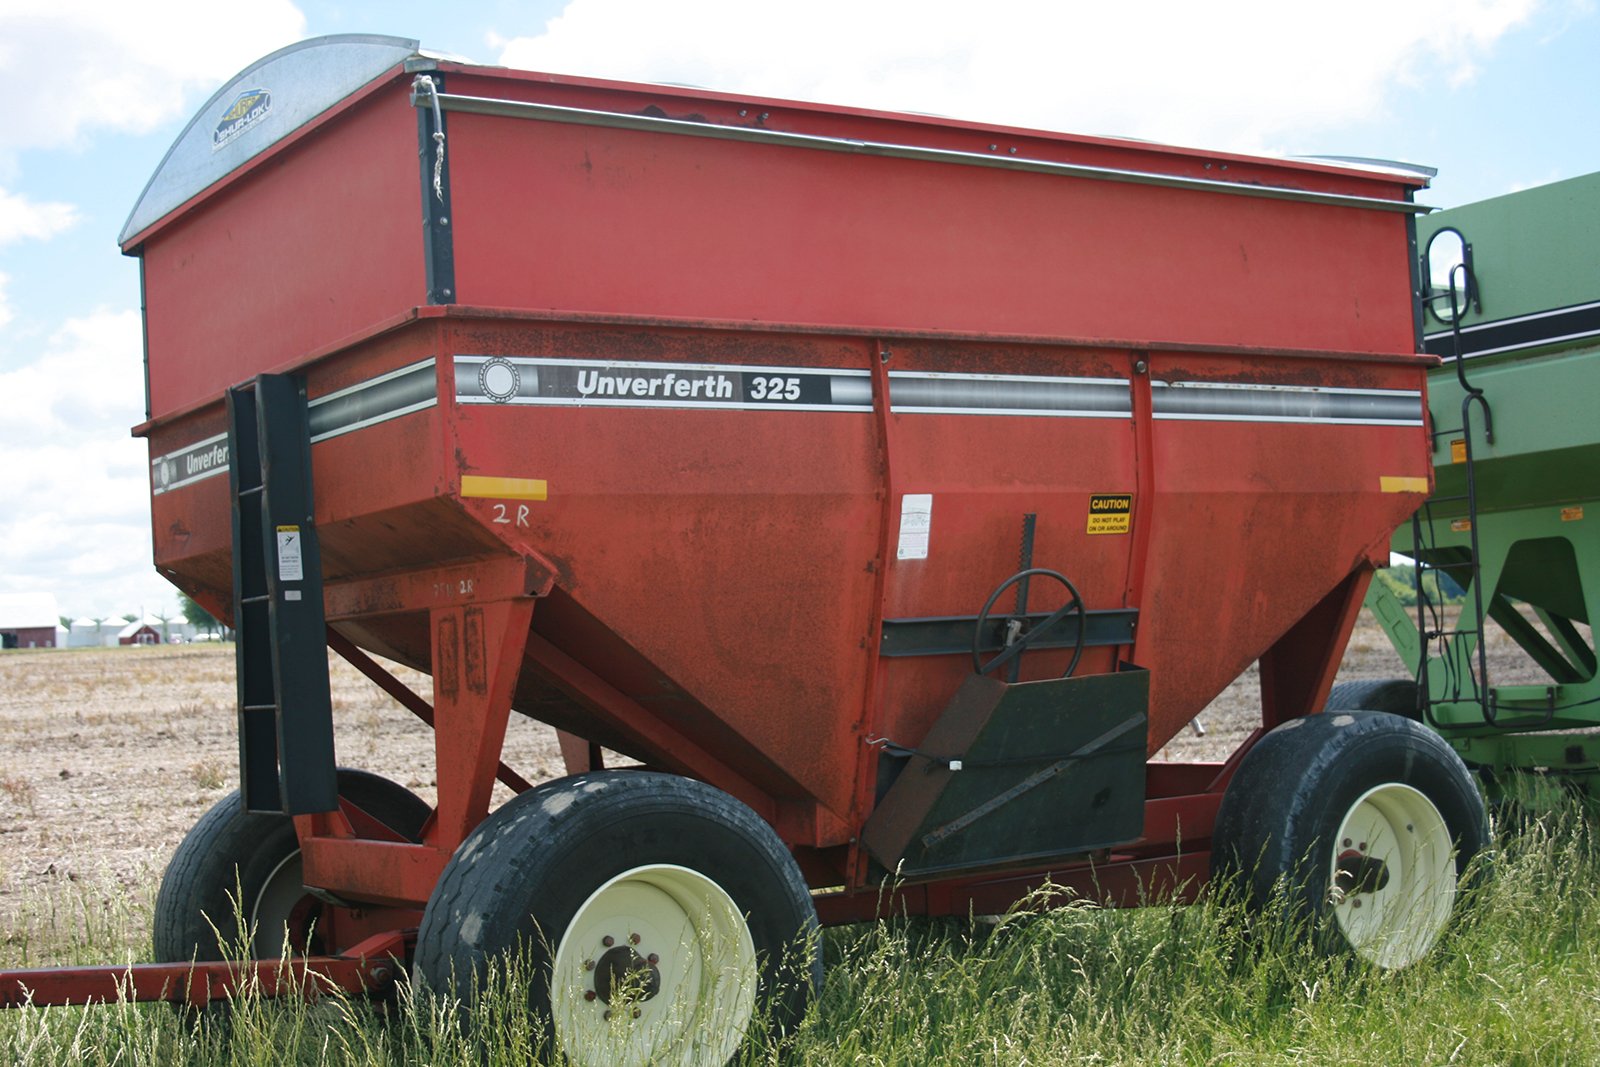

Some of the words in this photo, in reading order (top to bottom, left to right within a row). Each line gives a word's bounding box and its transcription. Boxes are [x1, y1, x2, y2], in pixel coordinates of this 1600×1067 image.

[219, 104, 265, 141] SHUR-LOK
[577, 370, 733, 398] Unverferth
[750, 376, 801, 400] 325
[186, 445, 229, 475] Unverfer
[492, 503, 511, 523] 2
[516, 504, 529, 528] R
[1092, 499, 1129, 509] CAUTION
